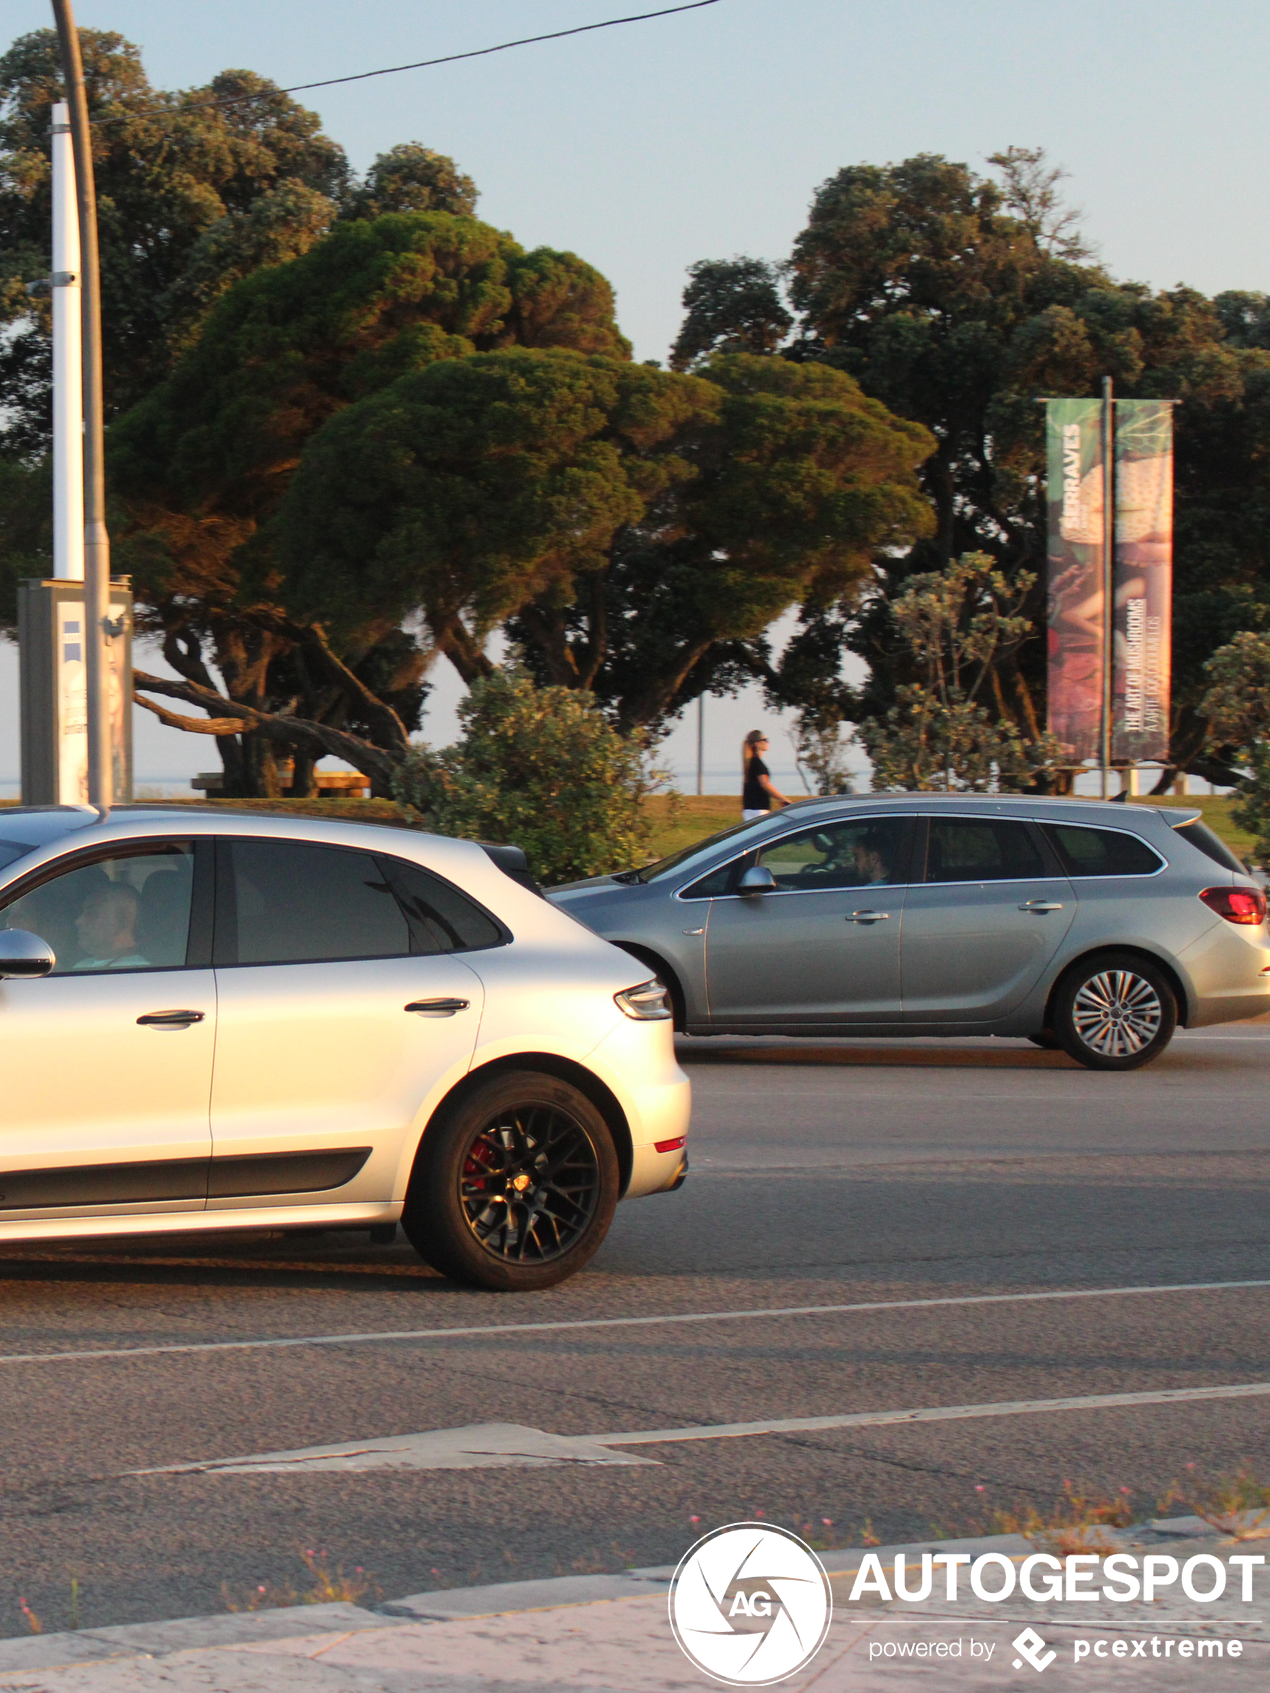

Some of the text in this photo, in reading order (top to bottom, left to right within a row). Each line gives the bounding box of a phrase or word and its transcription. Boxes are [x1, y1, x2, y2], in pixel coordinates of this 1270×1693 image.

[1063, 424, 1081, 529] SERRAVES
[1124, 599, 1143, 732] THE ART OF MUSHROOMS
[1144, 724, 1159, 732] A
